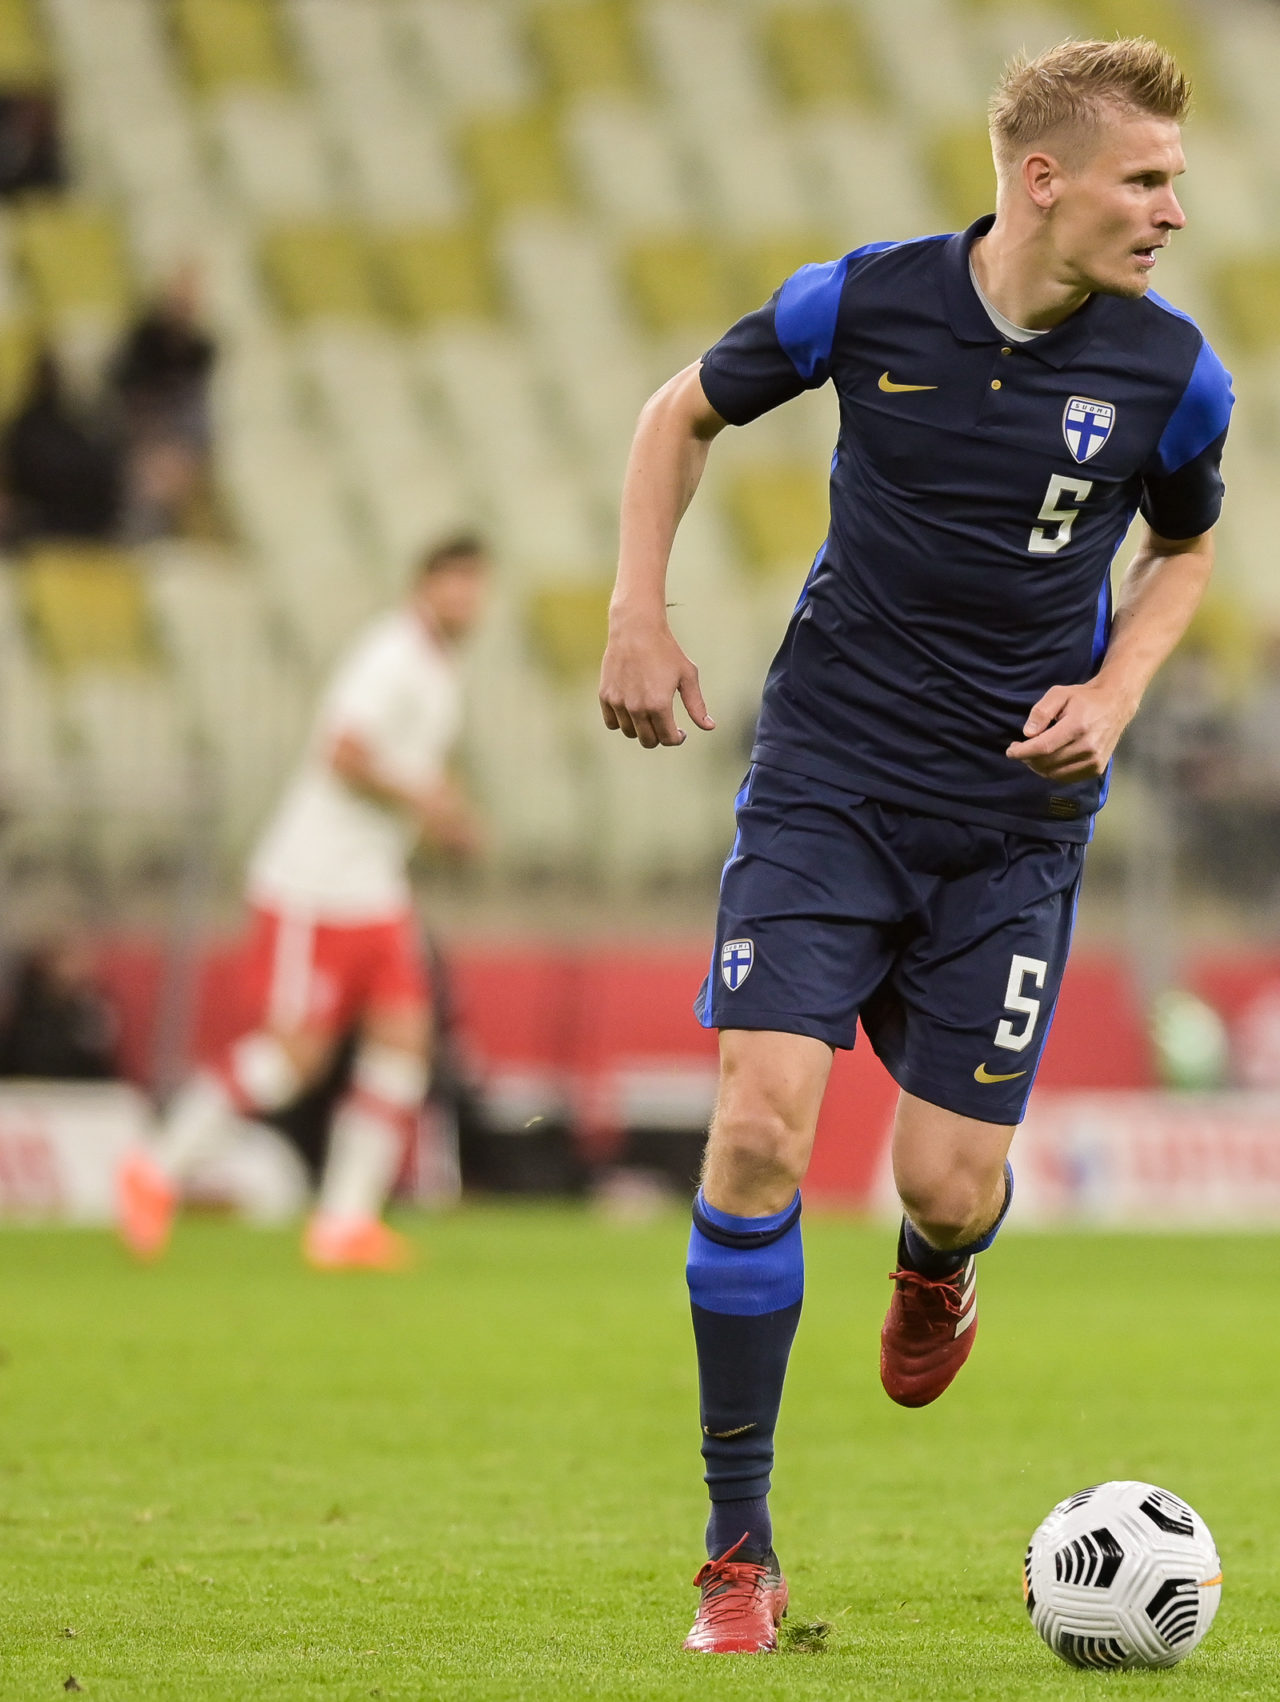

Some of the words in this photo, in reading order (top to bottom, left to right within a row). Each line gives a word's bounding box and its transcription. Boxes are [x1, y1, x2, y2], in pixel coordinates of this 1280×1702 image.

[1074, 403, 1109, 415] SUOMI
[1028, 473, 1093, 554] 5
[993, 954, 1048, 1053] 5
